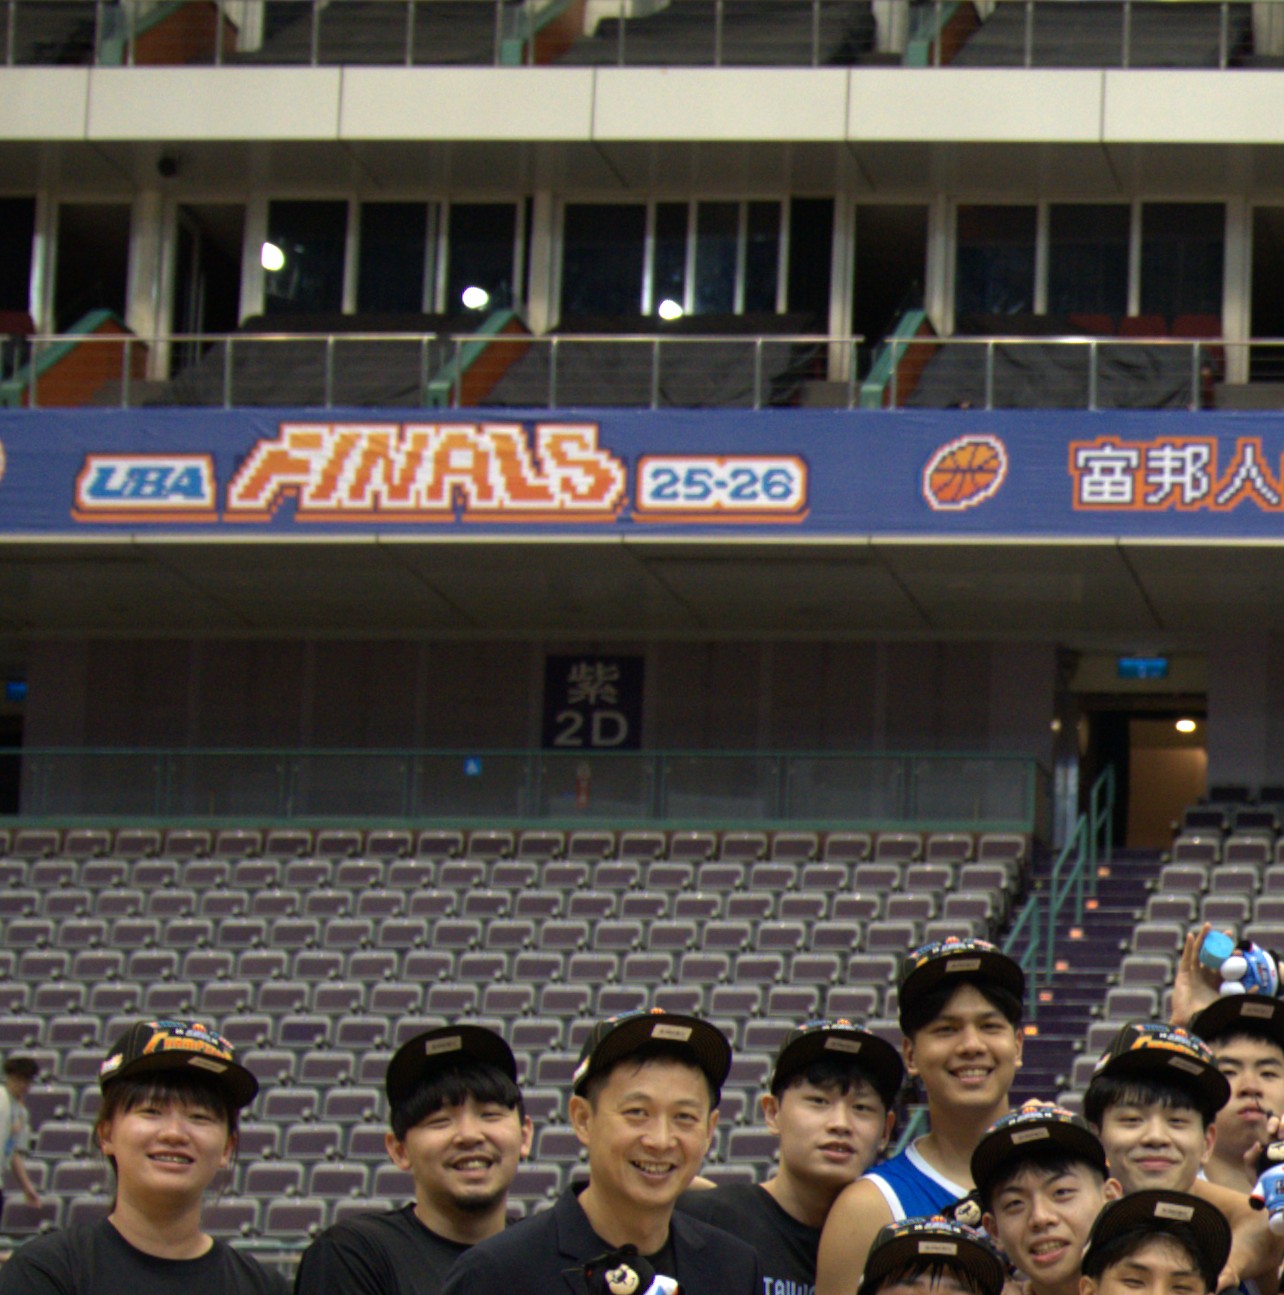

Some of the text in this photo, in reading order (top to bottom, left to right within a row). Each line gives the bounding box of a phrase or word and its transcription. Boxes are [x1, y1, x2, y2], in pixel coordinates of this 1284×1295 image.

[228, 428, 624, 508] FINALS
[649, 466, 796, 502] 25-26
[553, 710, 629, 747] 2D
